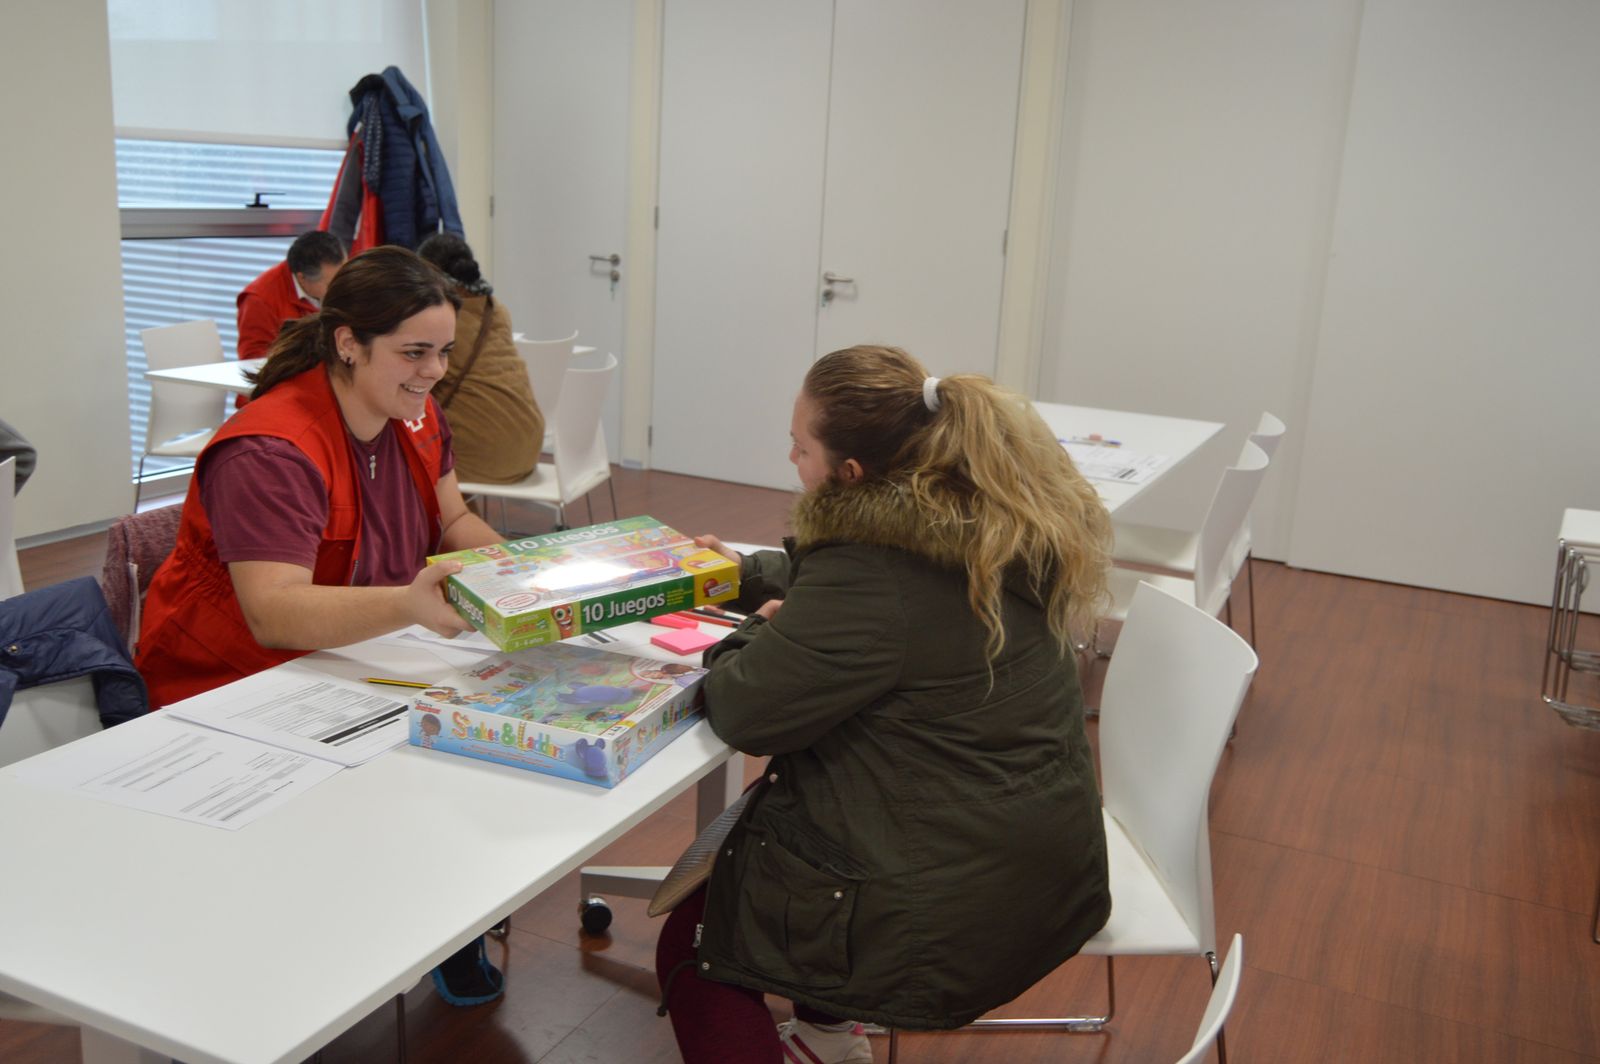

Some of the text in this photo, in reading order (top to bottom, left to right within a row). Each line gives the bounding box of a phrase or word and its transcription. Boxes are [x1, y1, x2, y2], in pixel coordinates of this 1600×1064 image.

[509, 525, 619, 551] 10 Juegos
[583, 603, 604, 624] 10
[607, 593, 665, 618] Juegos
[501, 722, 516, 747] &
